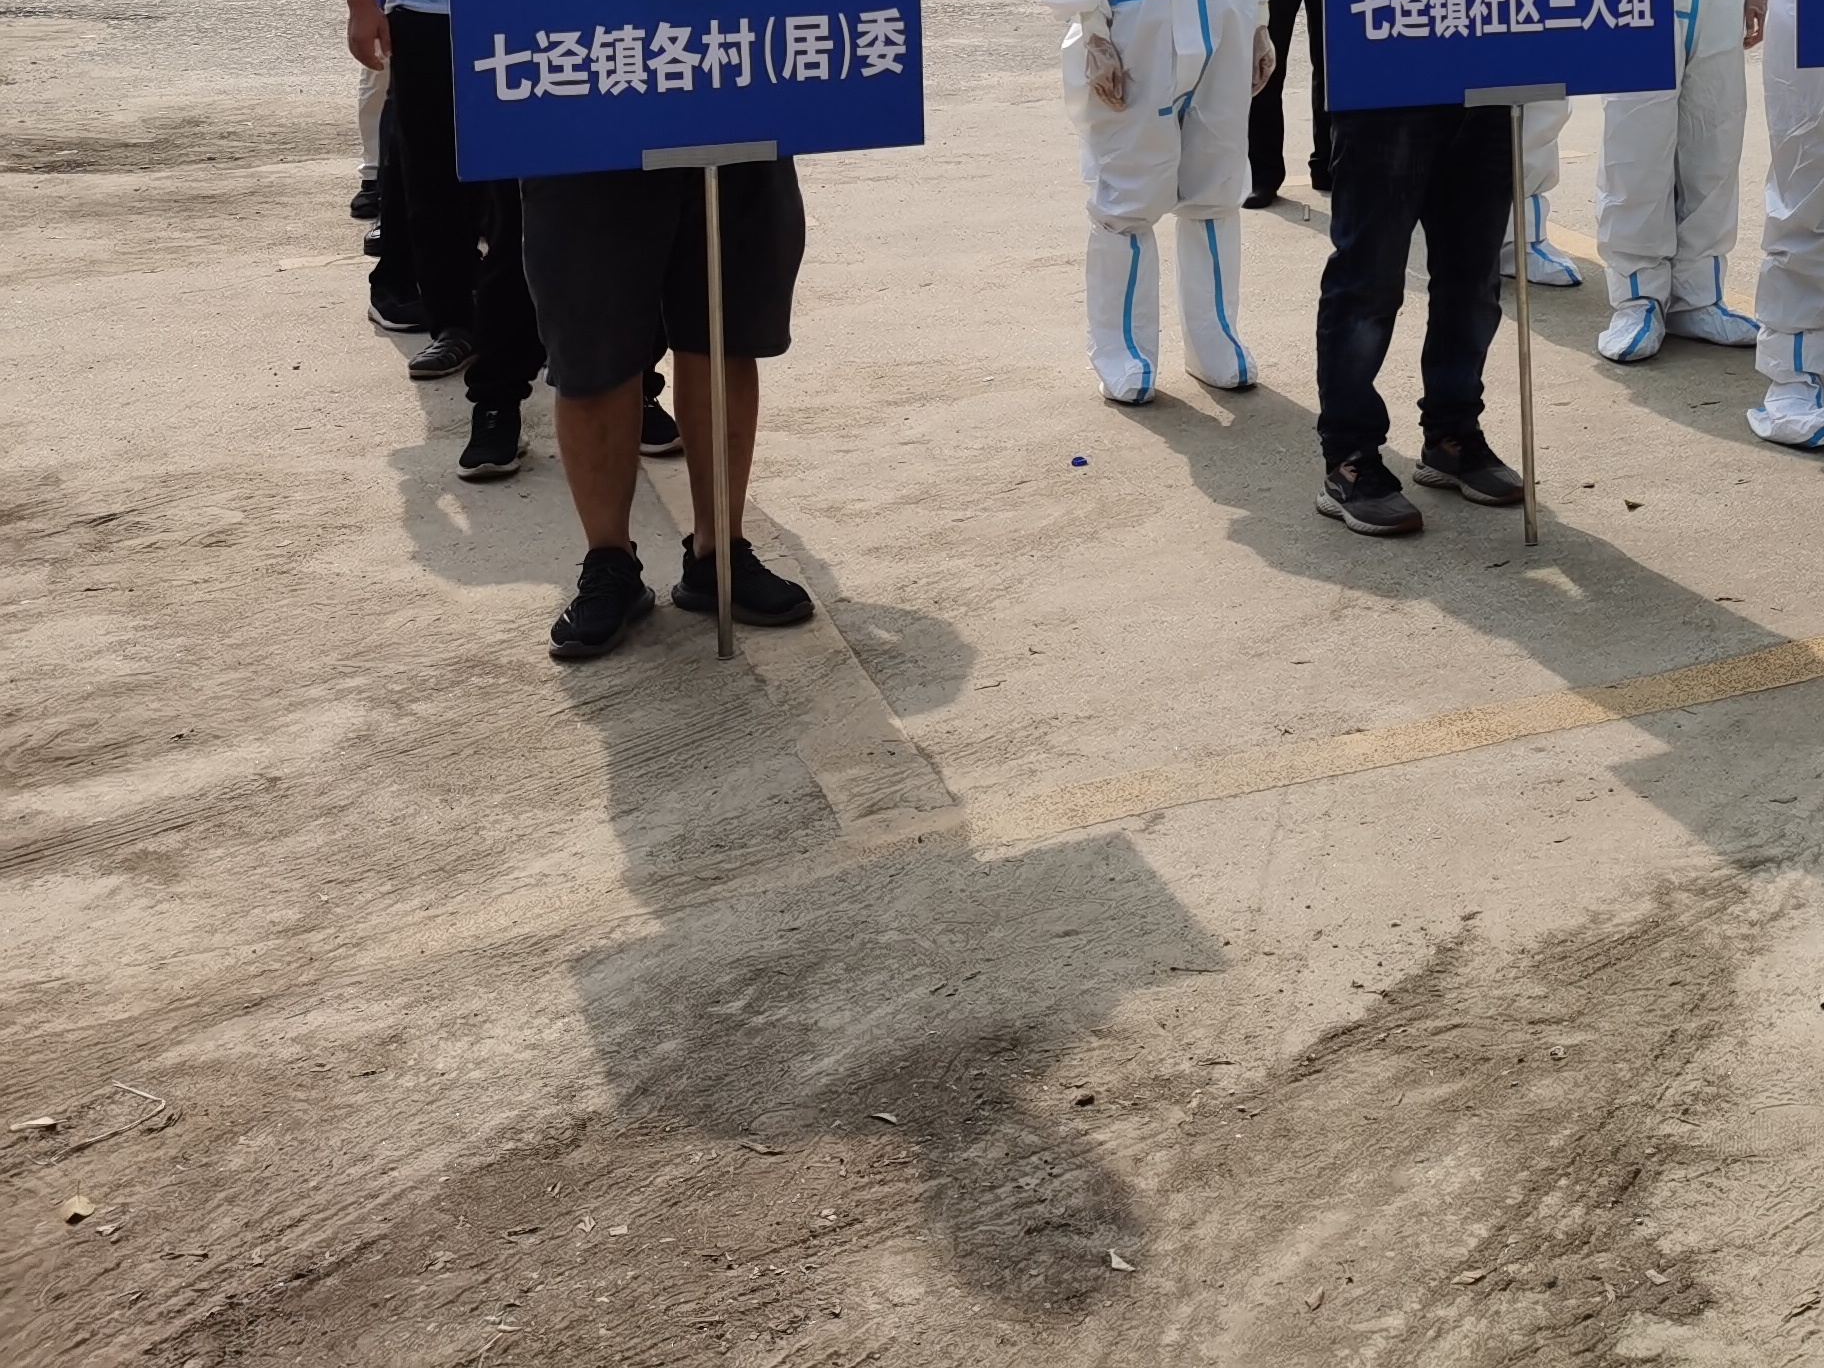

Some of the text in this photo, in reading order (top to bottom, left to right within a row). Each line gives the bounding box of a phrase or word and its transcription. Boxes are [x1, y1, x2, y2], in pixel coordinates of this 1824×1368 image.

[474, 7, 908, 101] 七迳镇各村(居)委
